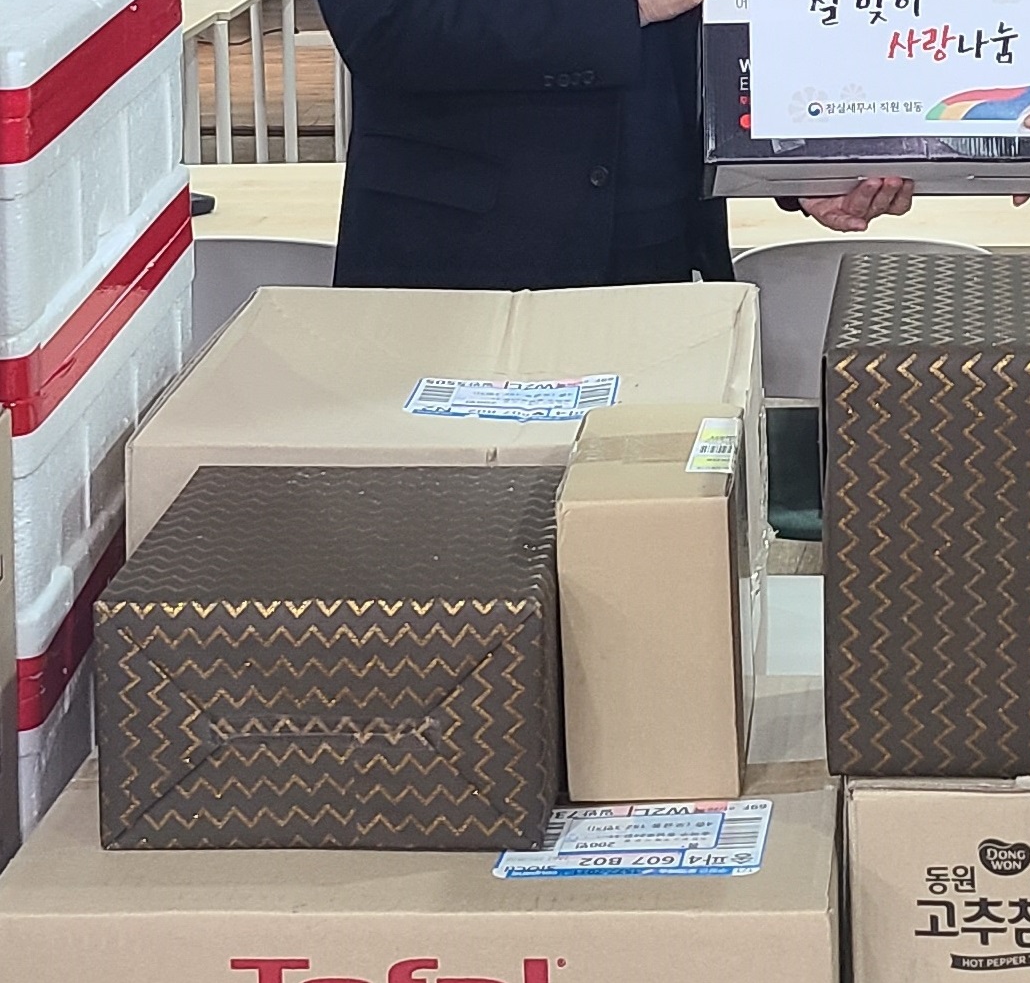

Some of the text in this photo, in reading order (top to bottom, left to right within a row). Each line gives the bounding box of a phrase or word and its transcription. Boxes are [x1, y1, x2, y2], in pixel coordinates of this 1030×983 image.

[887, 22, 1019, 64] 사랑나눔
[825, 100, 924, 114] 잠실세무서 직원 일동
[688, 852, 753, 866] 송파4
[986, 847, 1026, 861] DONG
[578, 856, 675, 867] 607 B02
[990, 861, 1022, 871] WON
[925, 865, 976, 895] 동원
[962, 957, 983, 968] HOT
[986, 956, 1026, 967] PEPPER
